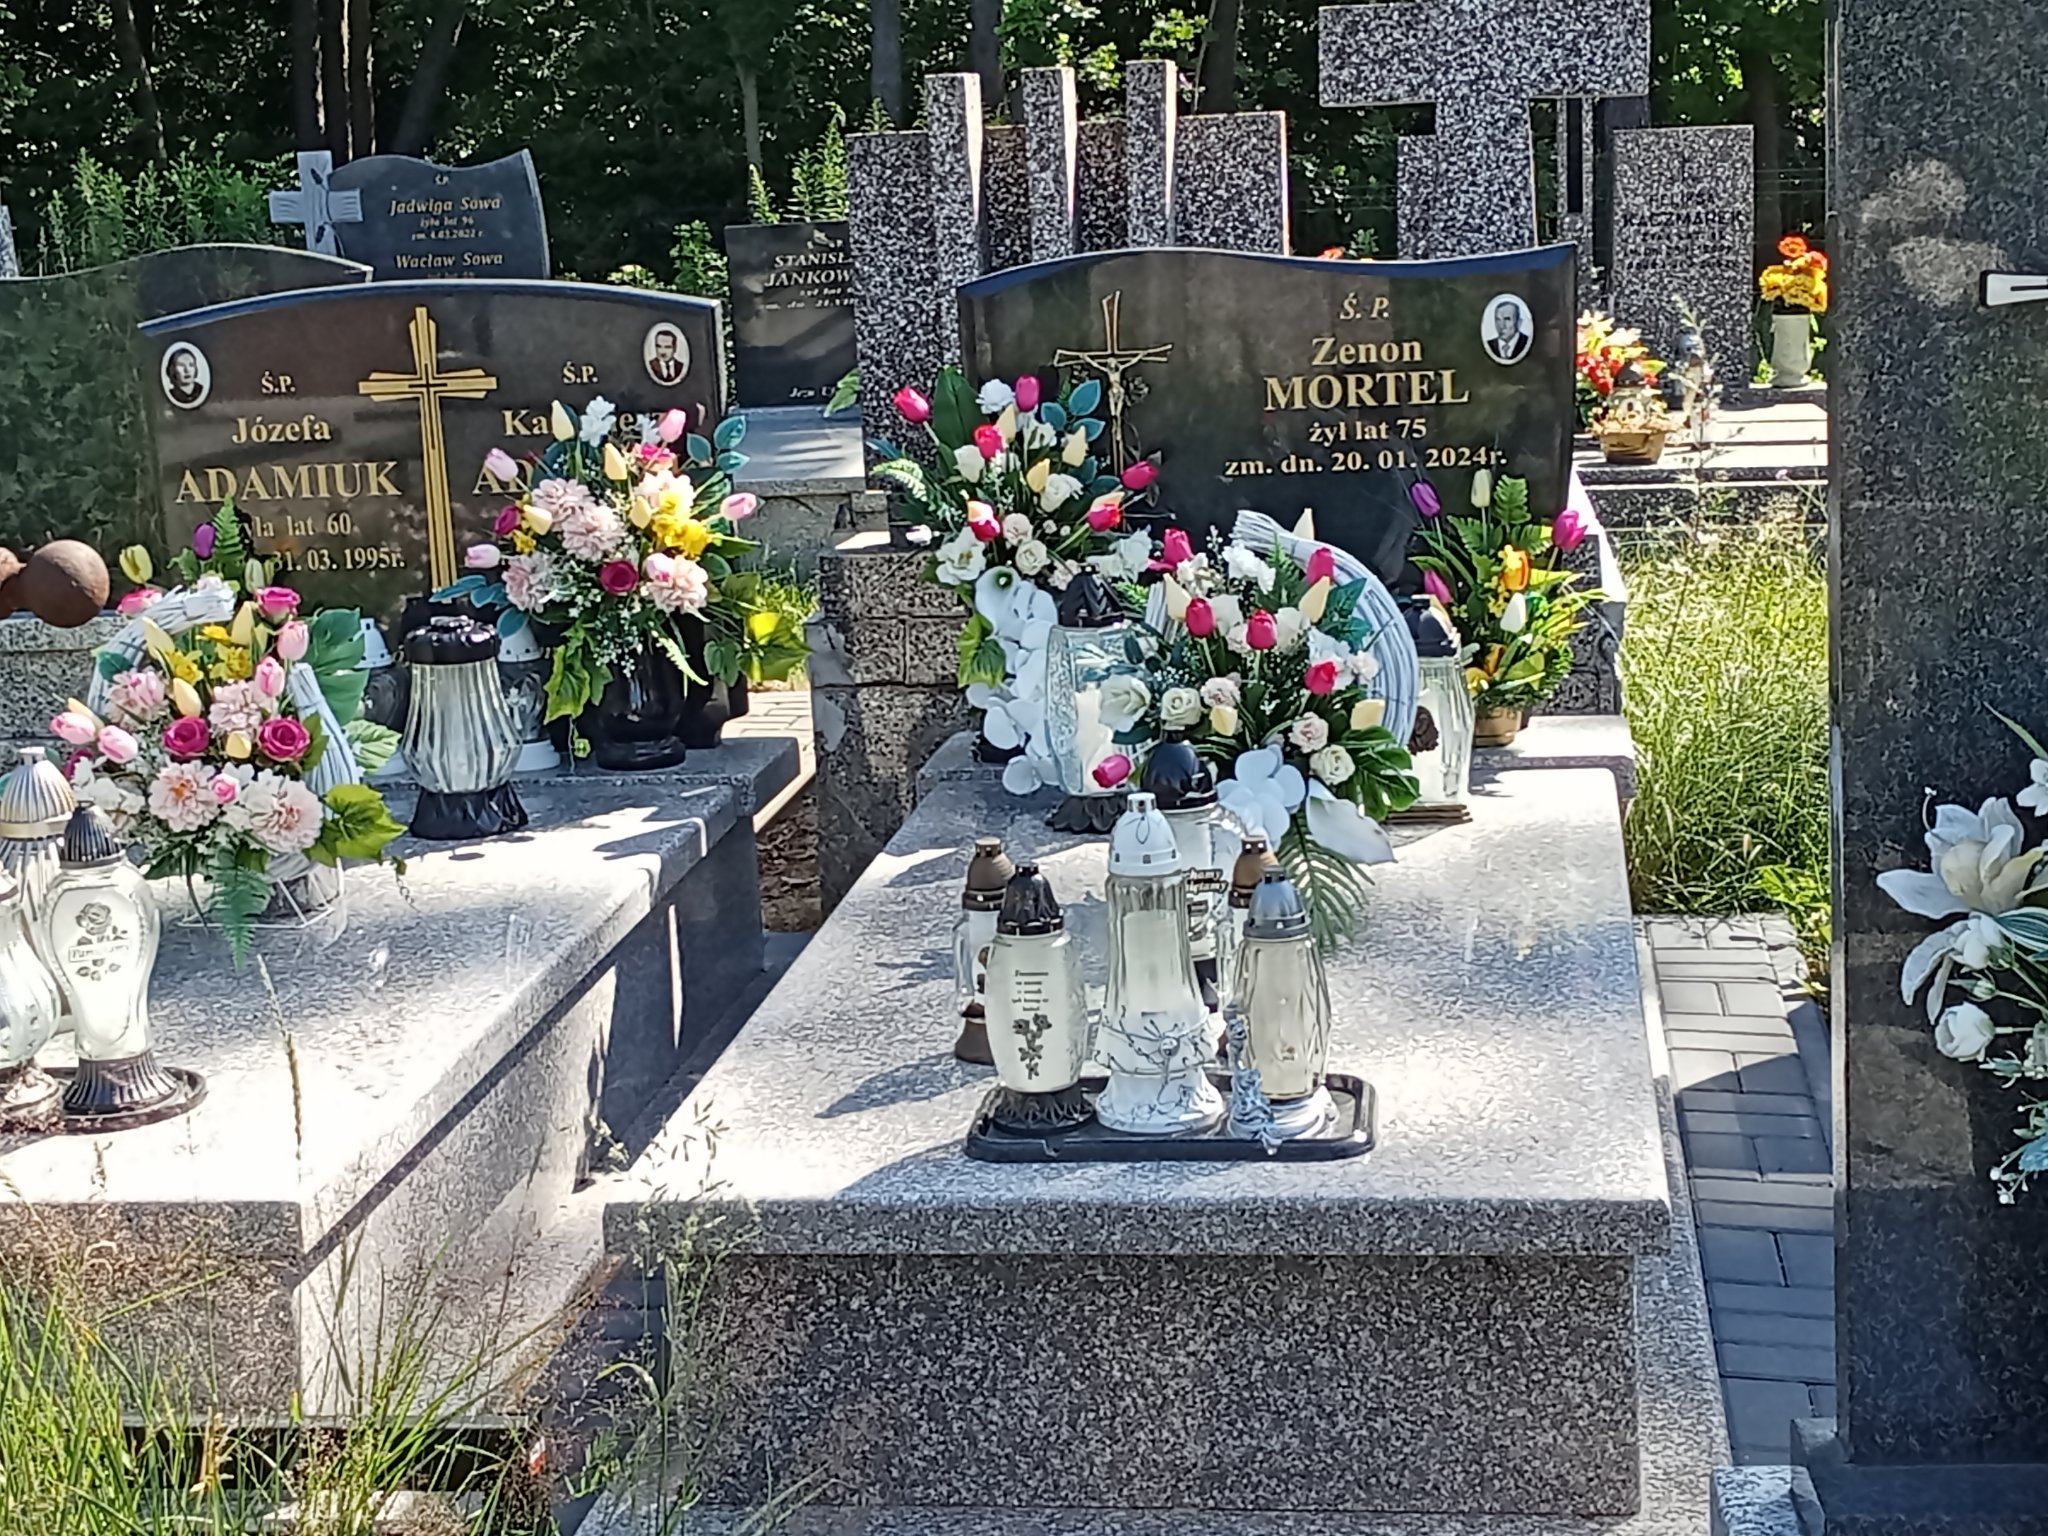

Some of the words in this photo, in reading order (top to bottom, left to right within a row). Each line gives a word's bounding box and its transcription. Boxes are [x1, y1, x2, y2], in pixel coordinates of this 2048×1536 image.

[389, 199, 454, 217] Jadwiga
[460, 196, 502, 211] Sowa
[1622, 210, 1749, 228] KACZMAREK
[395, 253, 456, 268] Wacław
[462, 251, 503, 266] Sowa
[764, 268, 854, 287] JANKOW
[1370, 296, 1390, 319] P.
[1311, 336, 1423, 367] Zenon
[261, 370, 297, 395] Ś.P.
[562, 360, 600, 384] Ś.P.
[1263, 368, 1471, 412] MORTEL
[232, 414, 332, 444] Józefa
[1309, 421, 1347, 447] żył
[1355, 420, 1391, 440] lat
[1396, 418, 1428, 439] 75
[1224, 459, 1274, 476] zm.
[1280, 454, 1324, 474] dn.
[1330, 450, 1371, 471] 20.
[1378, 449, 1418, 470] 01.
[1425, 446, 1508, 468] 2024r.
[174, 460, 403, 503] ADAMIUK
[286, 515, 315, 537] lat
[327, 511, 353, 535] 60
[306, 548, 339, 571] 03.
[343, 546, 406, 570] 1995r.
